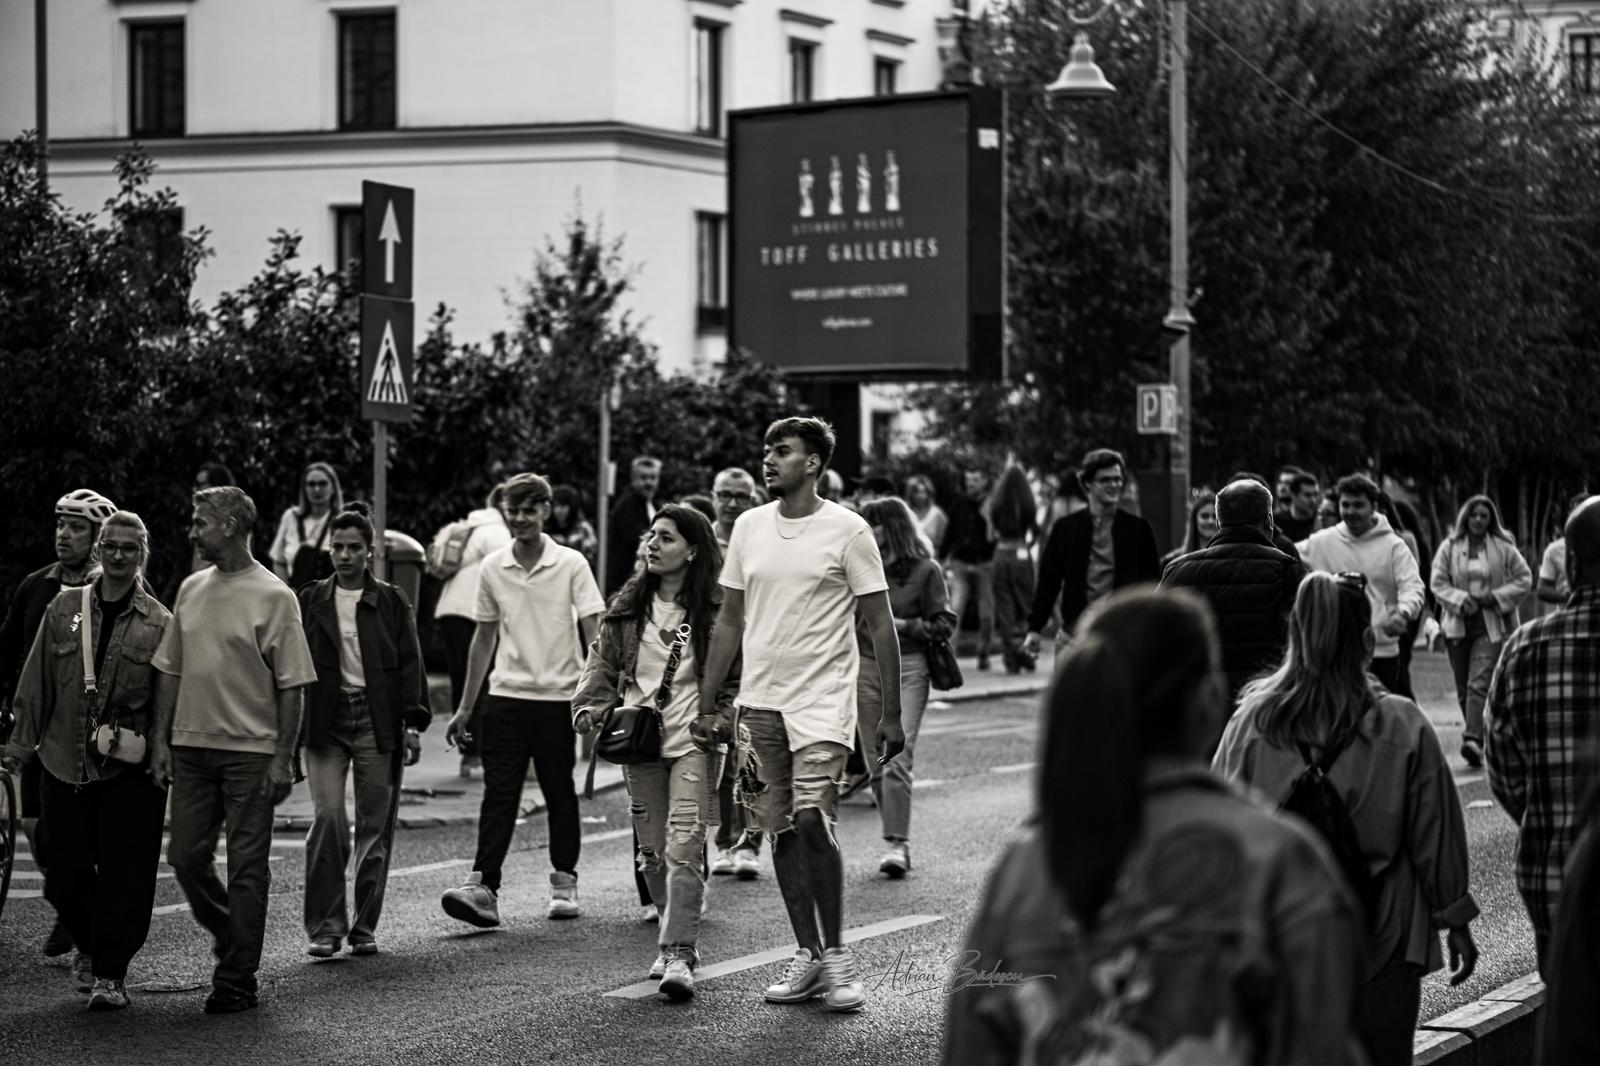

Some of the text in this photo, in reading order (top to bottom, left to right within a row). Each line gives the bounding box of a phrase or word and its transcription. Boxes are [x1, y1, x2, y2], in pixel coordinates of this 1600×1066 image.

[760, 236, 939, 266] TOFF GALLERIES
[1143, 391, 1159, 425] P
